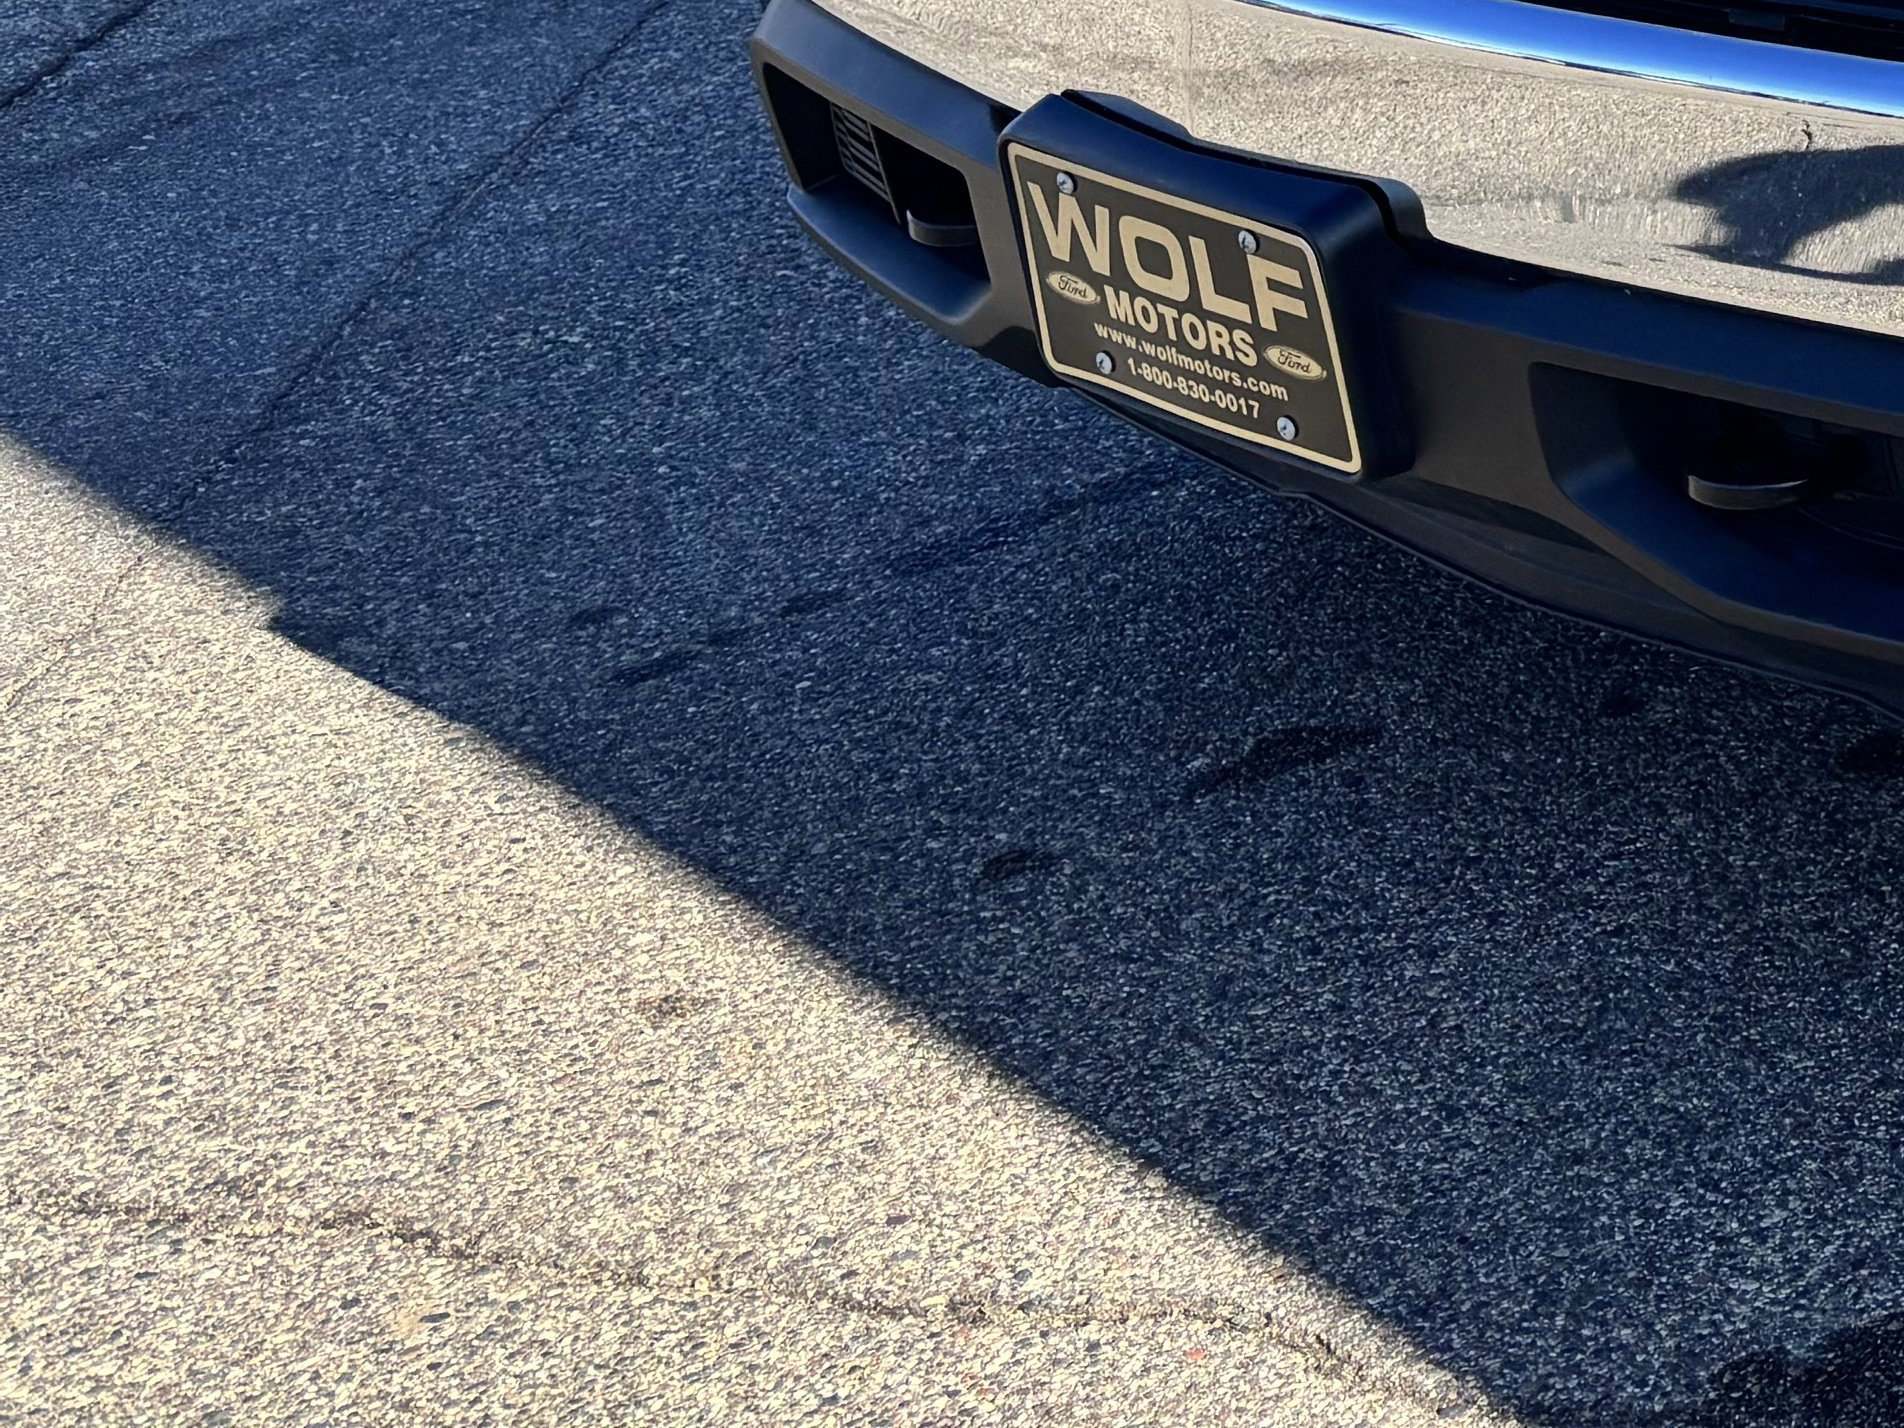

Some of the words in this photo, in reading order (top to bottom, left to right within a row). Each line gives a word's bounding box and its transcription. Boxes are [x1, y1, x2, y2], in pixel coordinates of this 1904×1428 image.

[1027, 181, 1308, 332] WOLF
[1094, 322, 1289, 402] www.wolfmotors.com
[1104, 284, 1258, 367] MOTORS
[1127, 357, 1260, 419] 1-800-830-0017
